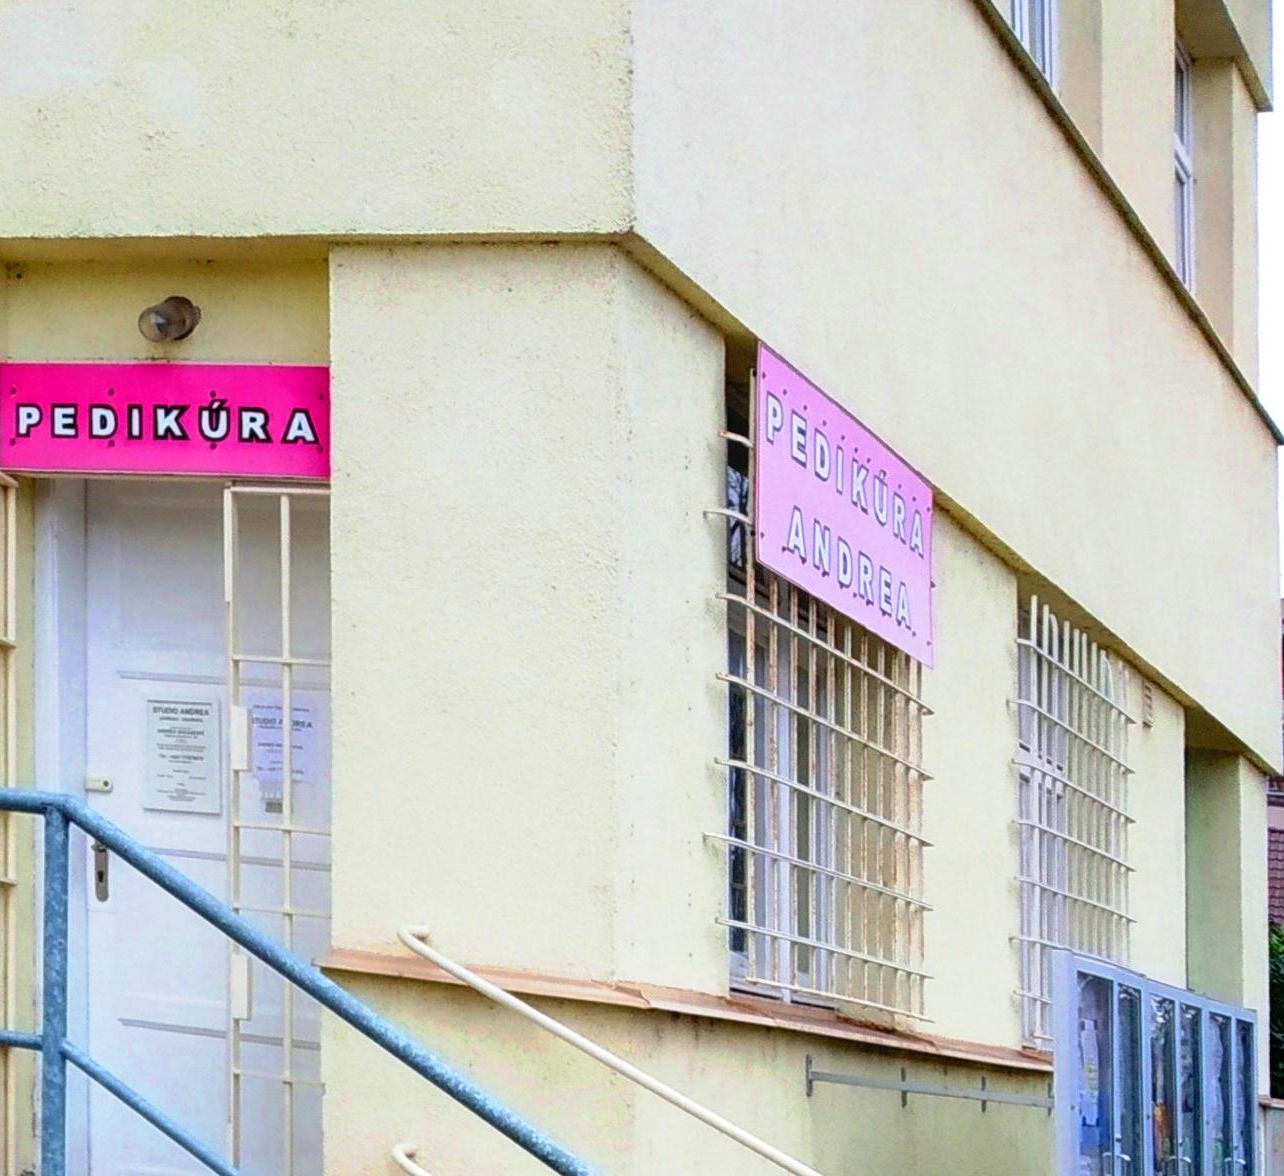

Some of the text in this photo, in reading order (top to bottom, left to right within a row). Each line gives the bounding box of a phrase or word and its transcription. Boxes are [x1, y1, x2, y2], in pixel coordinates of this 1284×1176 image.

[16, 399, 320, 443] PEDIKÚRA
[766, 390, 924, 558] PEDIKÚRA
[785, 505, 911, 630] ANDREA
[180, 708, 209, 716] ANDREA
